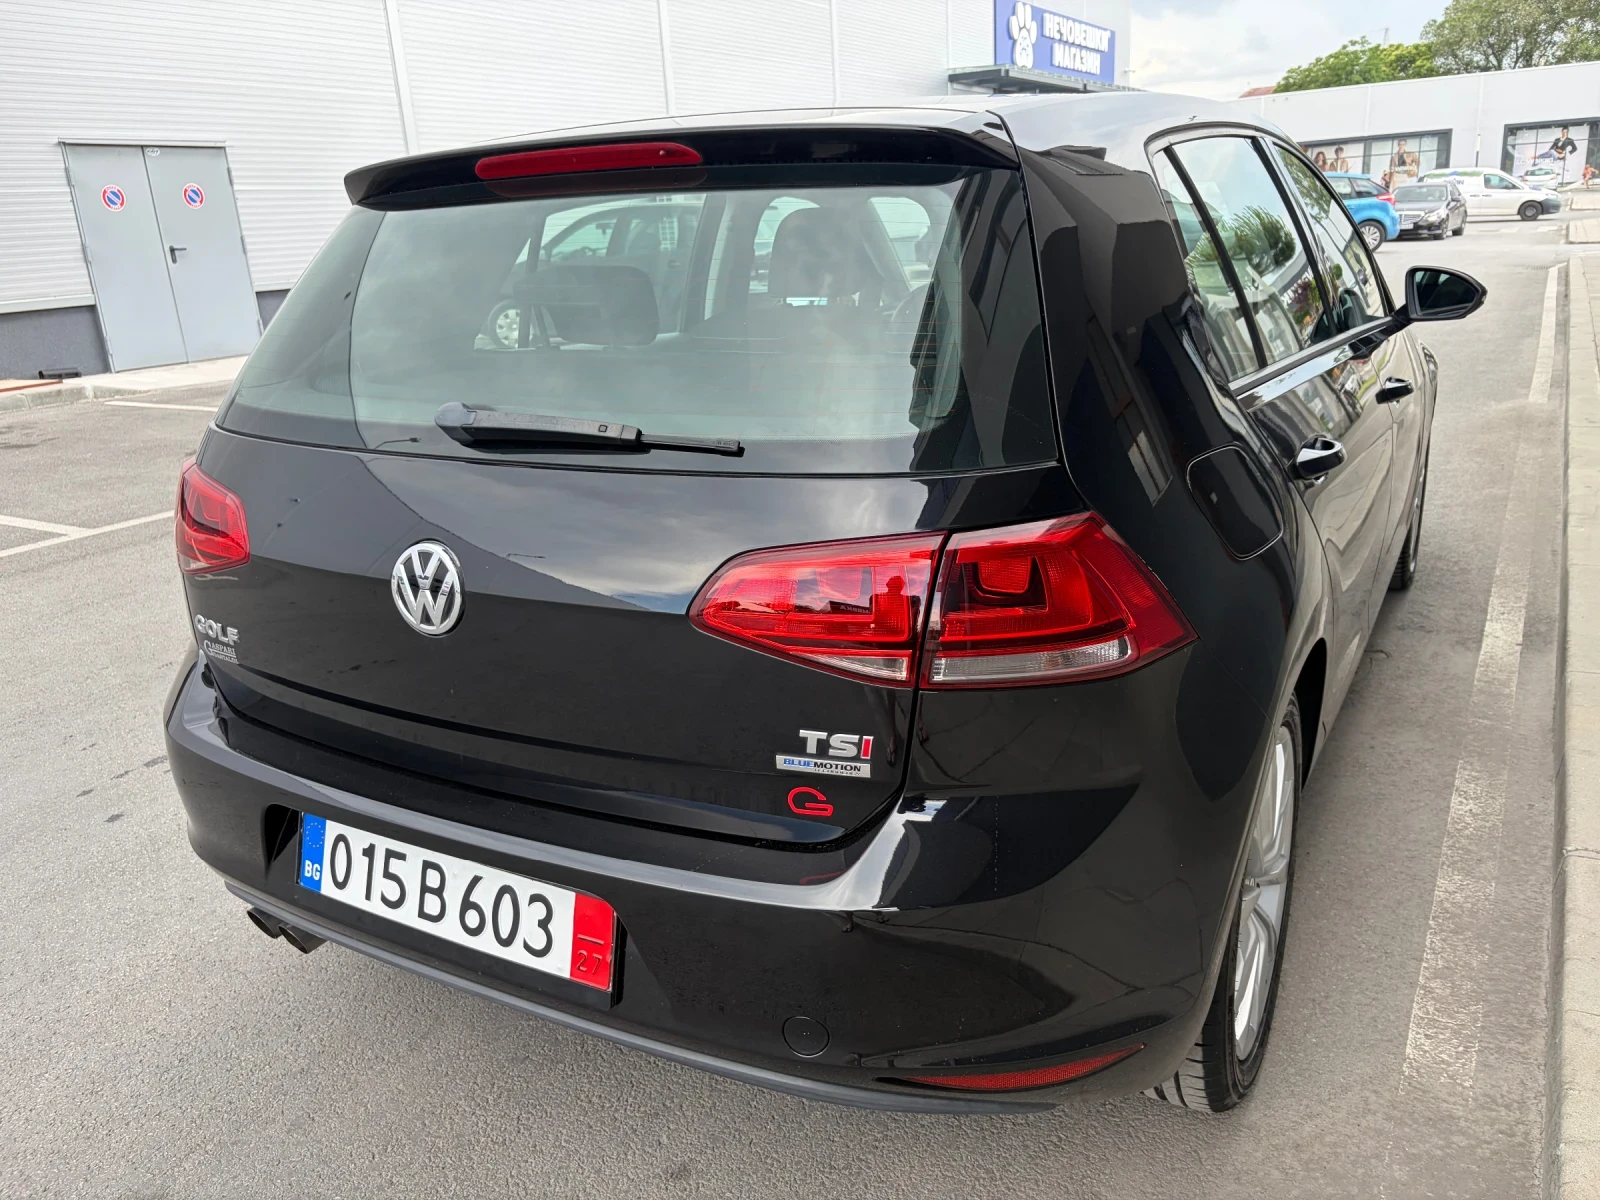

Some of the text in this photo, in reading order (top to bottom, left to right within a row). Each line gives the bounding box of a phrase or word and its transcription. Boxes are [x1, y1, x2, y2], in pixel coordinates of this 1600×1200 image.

[1043, 13, 1110, 52] НЕЧОВЕШКИ
[1051, 42, 1100, 75] МАГАЗИН
[194, 614, 239, 645] GOLF
[799, 729, 874, 759] TSI
[783, 757, 861, 772] BLUEMOTION
[304, 859, 321, 881] BG
[577, 949, 603, 975] 27
